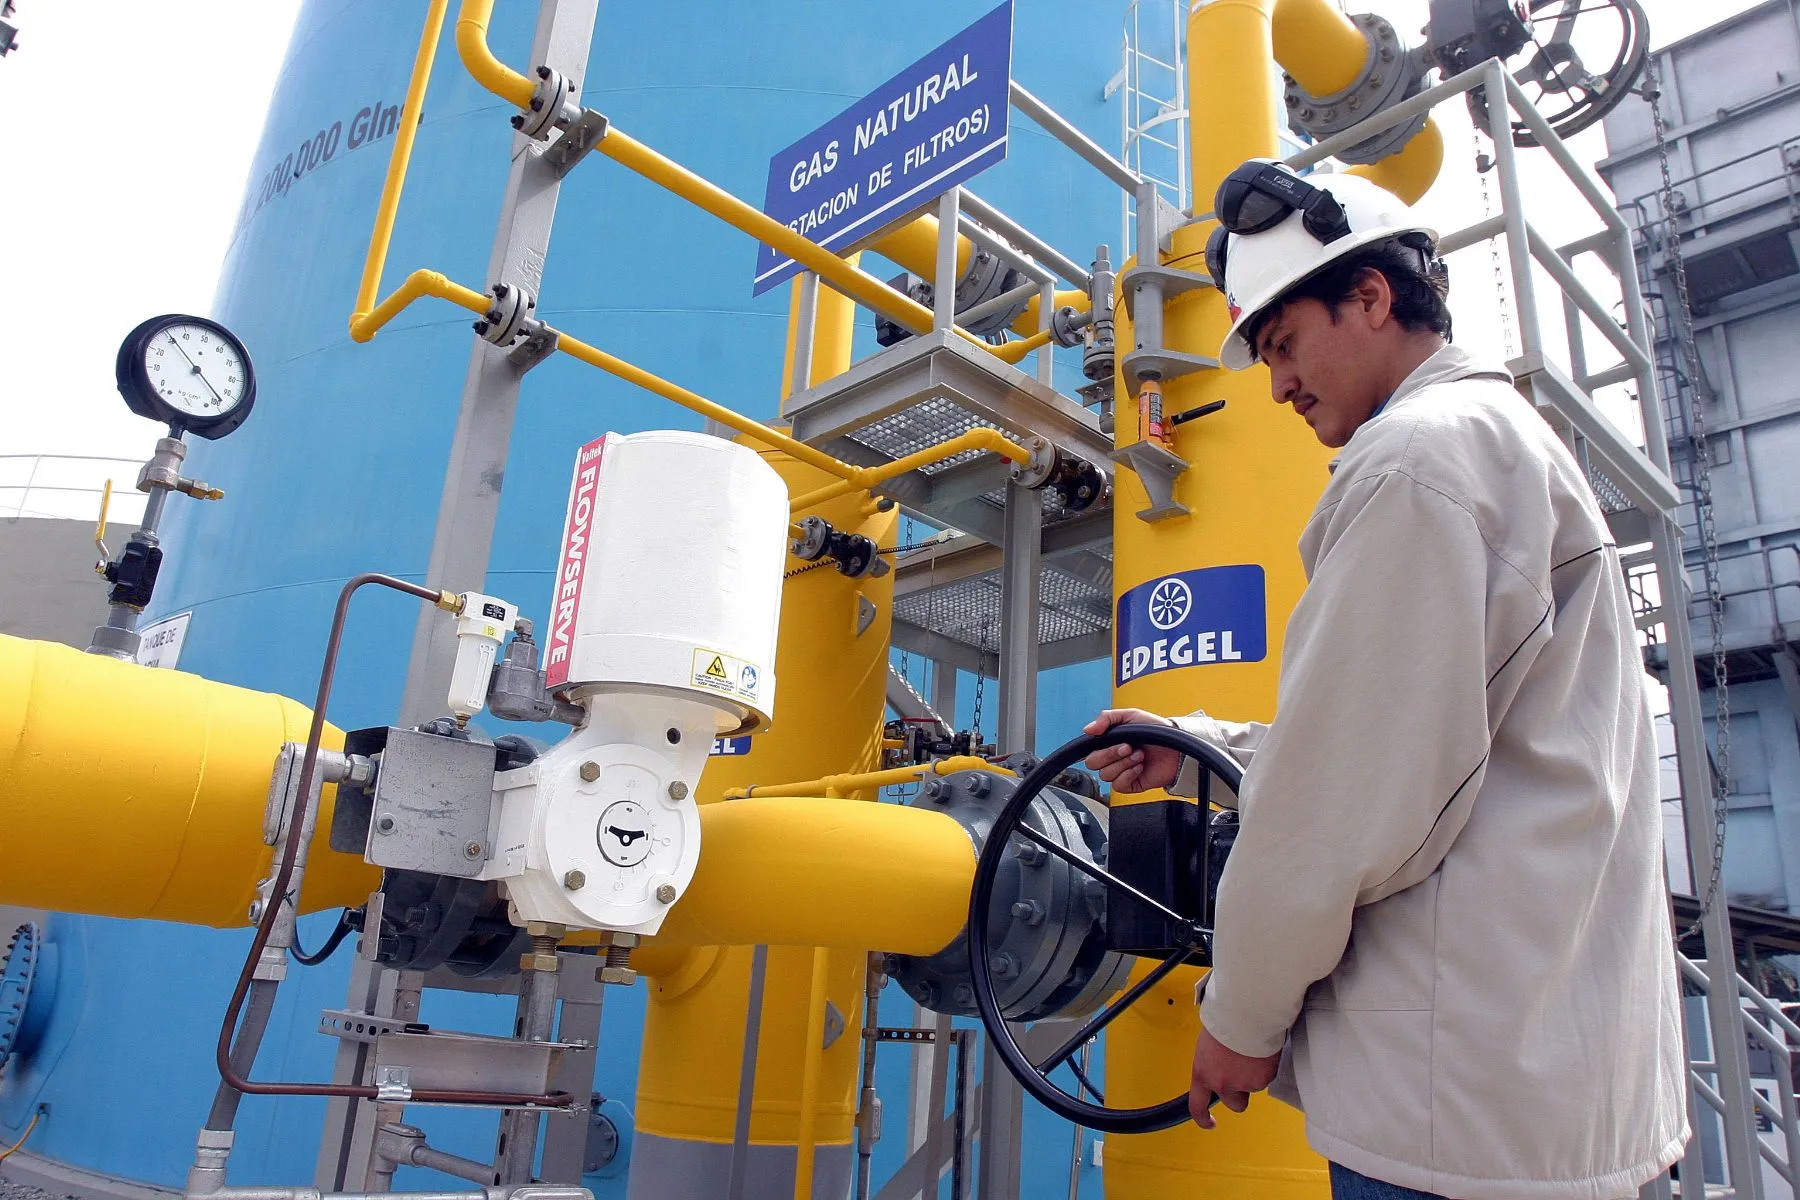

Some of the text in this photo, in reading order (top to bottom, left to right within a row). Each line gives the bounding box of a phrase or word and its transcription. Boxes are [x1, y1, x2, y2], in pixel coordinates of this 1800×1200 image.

[789, 53, 978, 193] GAS NATURAL
[867, 162, 893, 196] DE
[903, 103, 990, 175] FILTROS)
[255, 120, 342, 213] 200,000
[155, 348, 164, 357] 20
[215, 345, 224, 354] 60
[225, 359, 233, 367] 70
[551, 465, 596, 665] FLOWSERVE
[1121, 630, 1242, 682] EDEGEL
